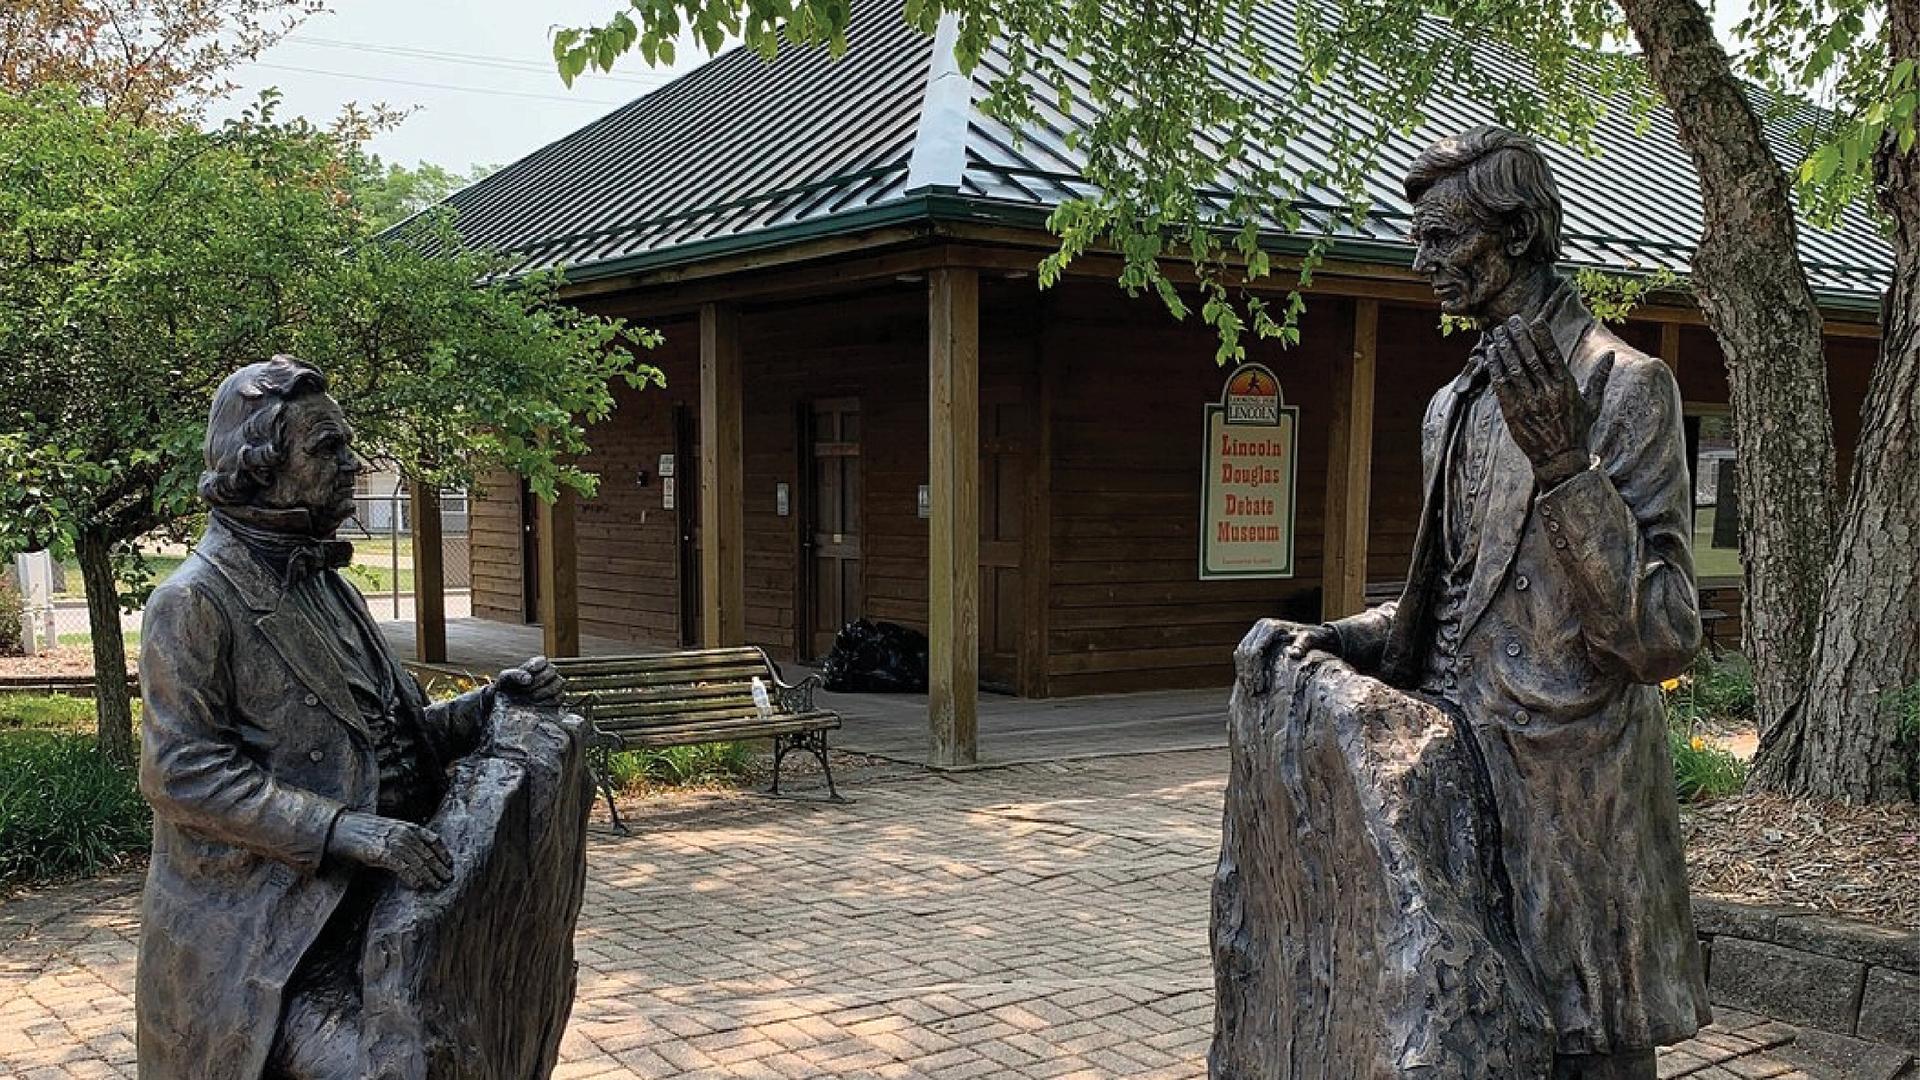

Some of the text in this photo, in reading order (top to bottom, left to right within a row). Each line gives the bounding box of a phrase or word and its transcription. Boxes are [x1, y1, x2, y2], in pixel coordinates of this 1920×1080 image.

[1229, 405, 1277, 419] LINCOLN
[1222, 433, 1281, 456] Lincoln
[1222, 463, 1280, 487] Douglas
[1225, 494, 1274, 515] Debate
[1217, 521, 1280, 542] Museum
